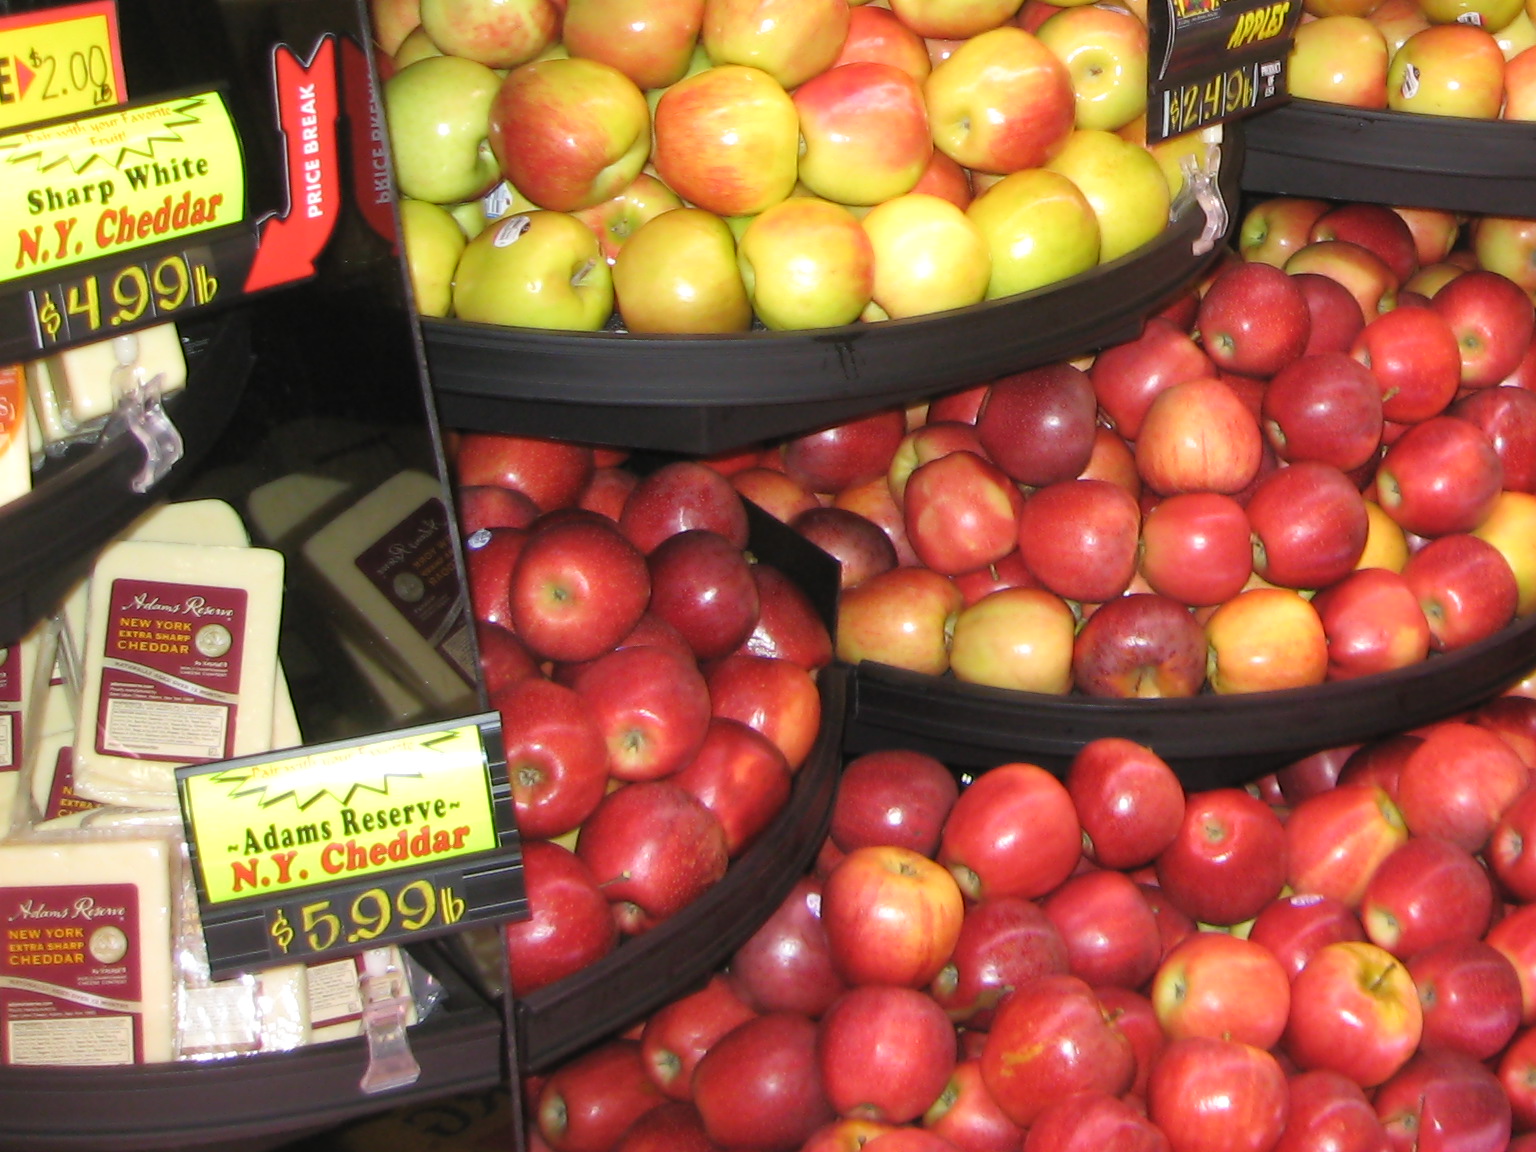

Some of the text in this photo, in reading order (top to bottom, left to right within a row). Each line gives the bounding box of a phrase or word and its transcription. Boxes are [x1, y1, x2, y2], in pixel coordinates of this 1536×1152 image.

[1226, 0, 1291, 50] APPLES
[1170, 69, 1244, 130] $2.49
[299, 83, 323, 218] PRICE BREAK
[28, 156, 209, 215] Sharp White
[16, 191, 224, 270] N.Y. Cheddar
[40, 254, 191, 342] $4.99
[120, 617, 192, 631] NEW YORK
[122, 592, 234, 618] Adams Reserve
[117, 640, 190, 654] CHEDDAR
[119, 630, 191, 642] EXTRA SHARP
[231, 825, 470, 893] N.Y. Cheddar
[8, 896, 126, 922] Adams Reserve
[272, 879, 437, 954] $5.99
[8, 928, 84, 940] NEW YORK
[10, 942, 85, 952] EXTRA SHARP
[9, 953, 85, 966] CHEDDAR
